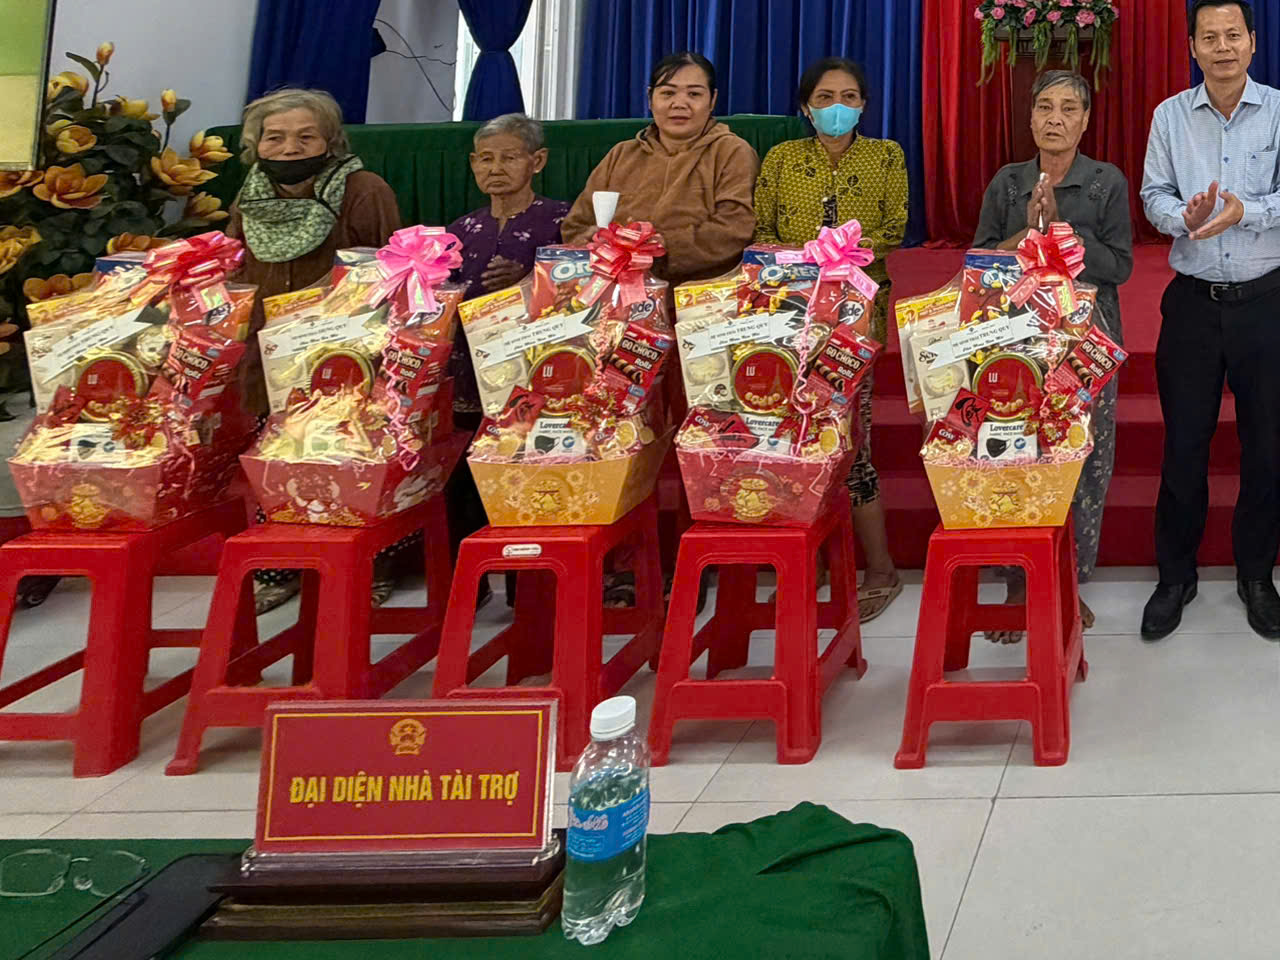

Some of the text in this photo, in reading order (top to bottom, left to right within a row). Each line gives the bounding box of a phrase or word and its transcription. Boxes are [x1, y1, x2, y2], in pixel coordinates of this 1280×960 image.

[622, 340, 658, 360] GO CHOCO
[825, 346, 861, 369] GO CHOCO
[1082, 341, 1113, 369] GO CHOCO
[988, 372, 998, 383] LU
[540, 422, 567, 430] Loverca
[990, 424, 1024, 432] Lovercare
[290, 769, 520, 808] ĐẠI DIỆN NHÀ TÀI TRỢ
